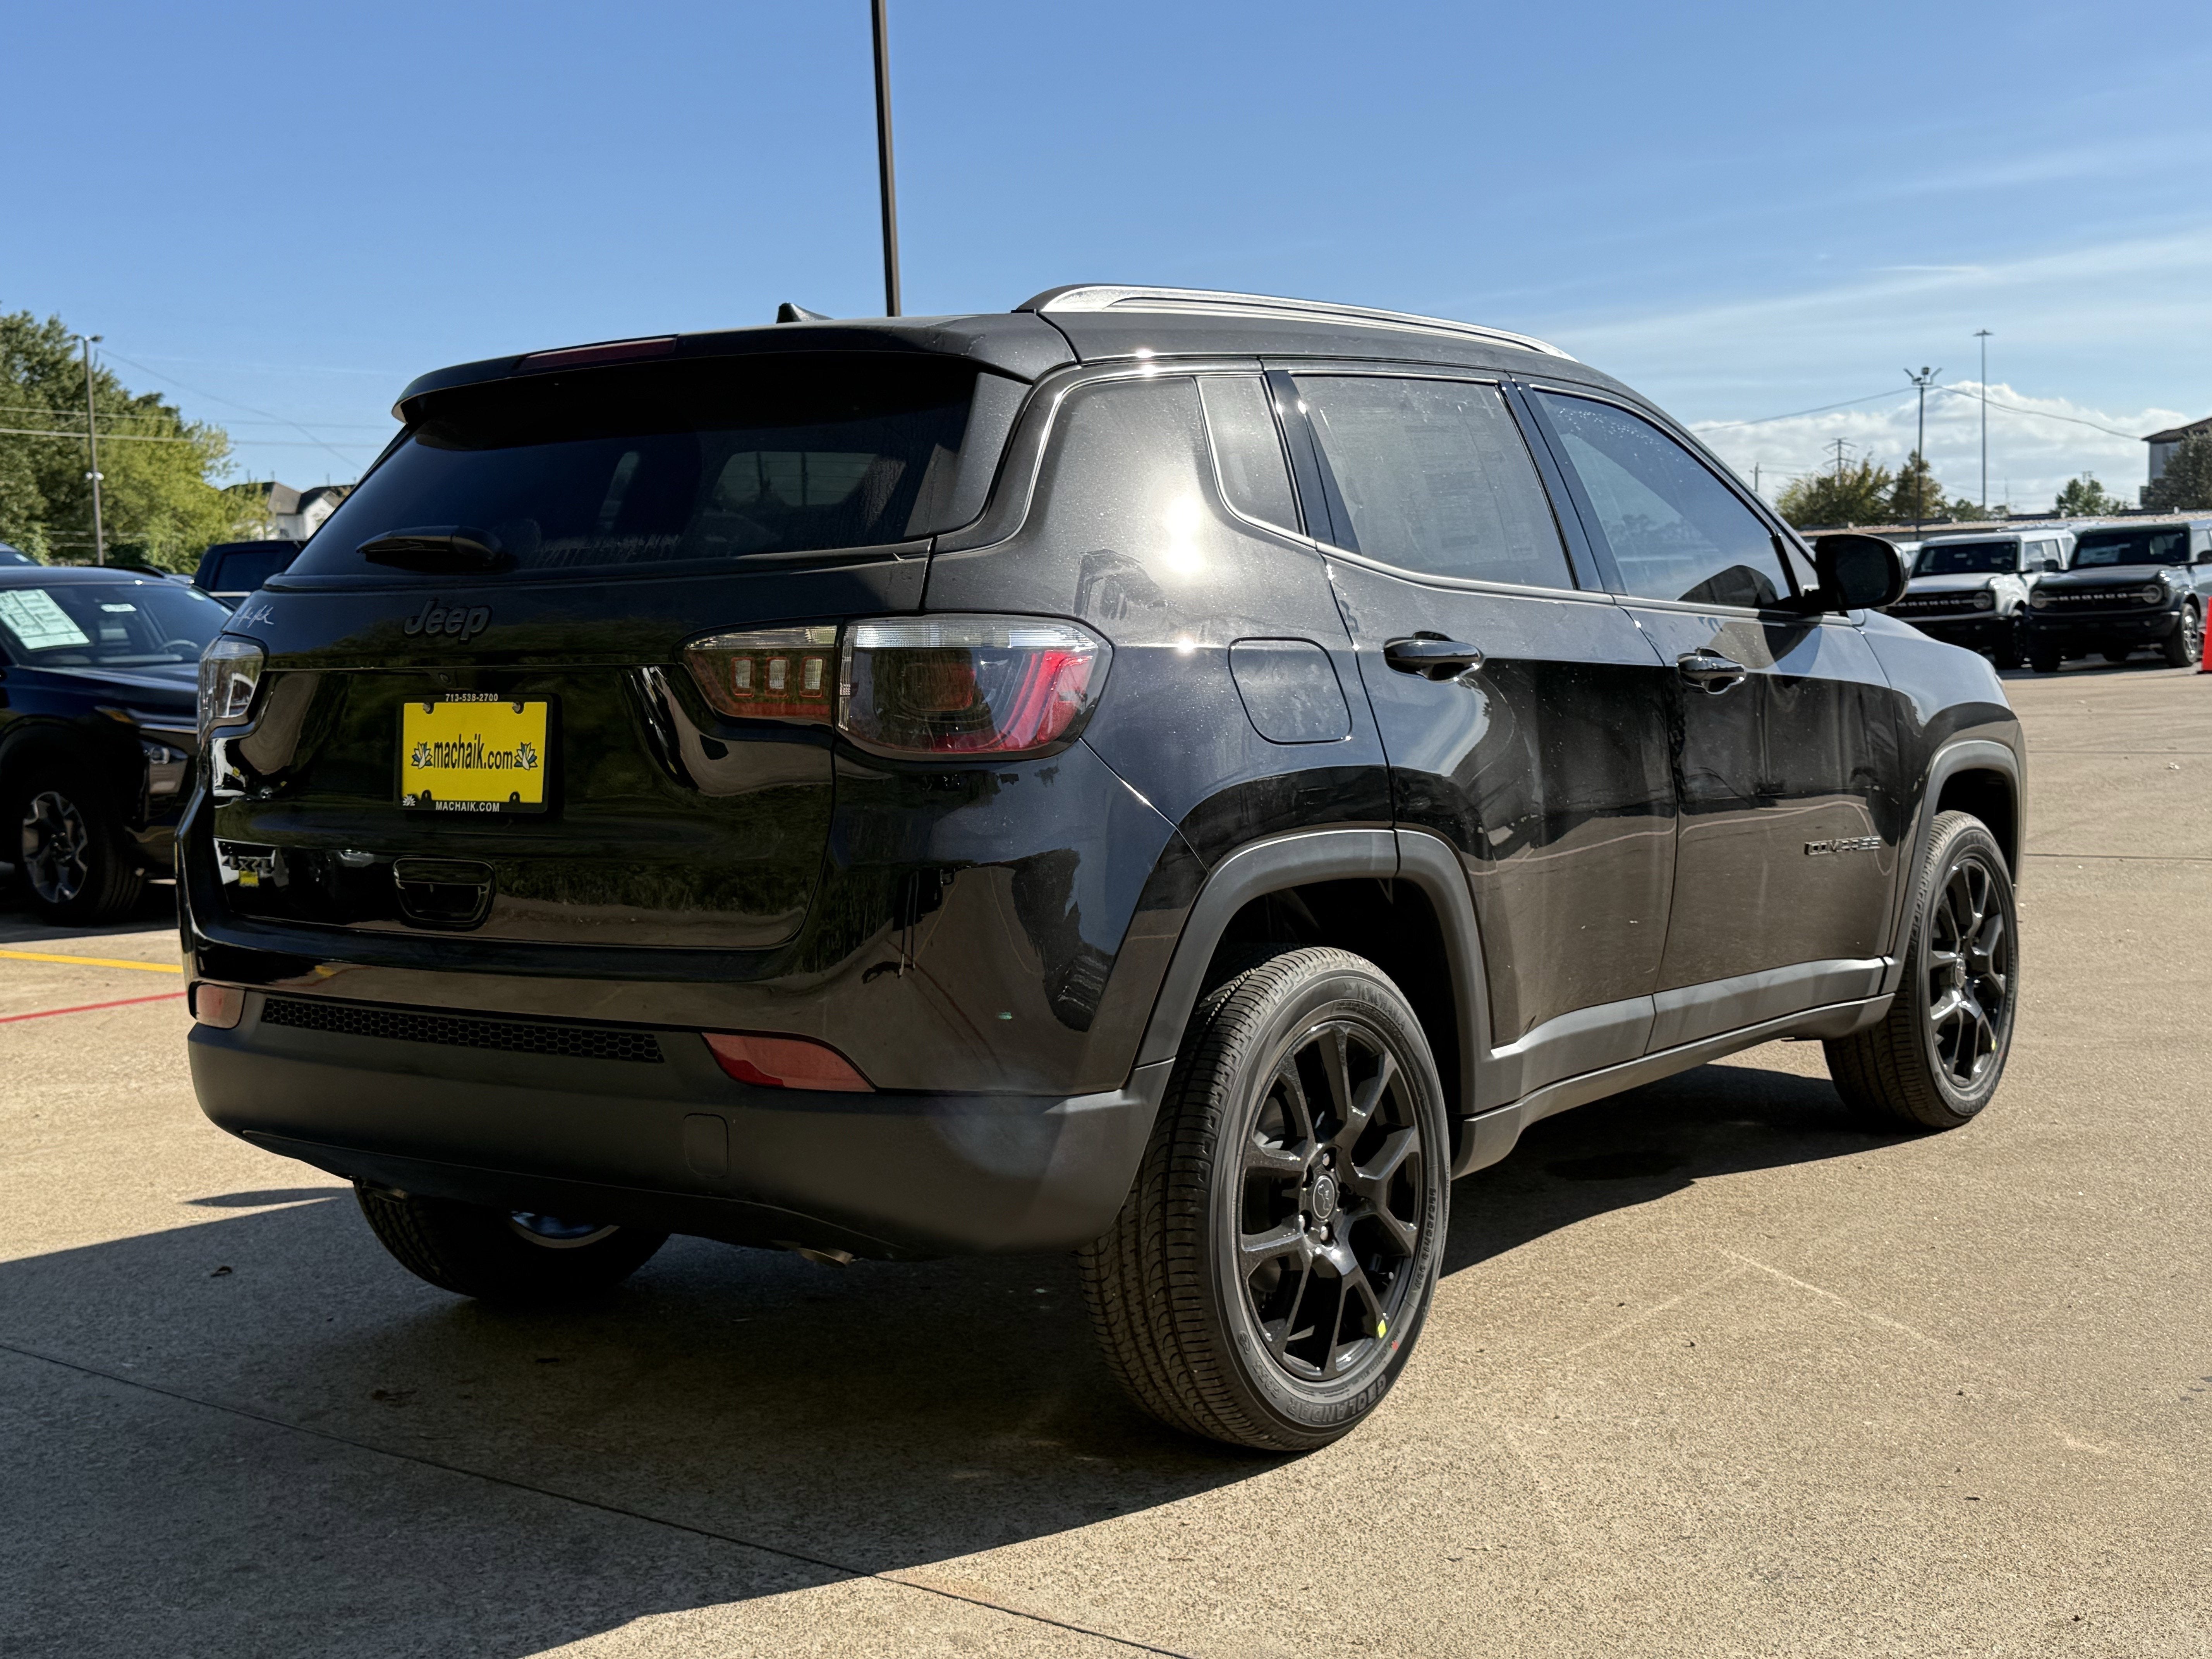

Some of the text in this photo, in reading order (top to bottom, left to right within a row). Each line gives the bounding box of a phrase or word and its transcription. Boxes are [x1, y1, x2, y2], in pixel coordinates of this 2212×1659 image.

[404, 598, 493, 643] Jeep
[445, 693, 498, 702] 713-538-2700
[433, 733, 513, 769] machaik.com
[436, 801, 500, 812] MACHAIK.COM
